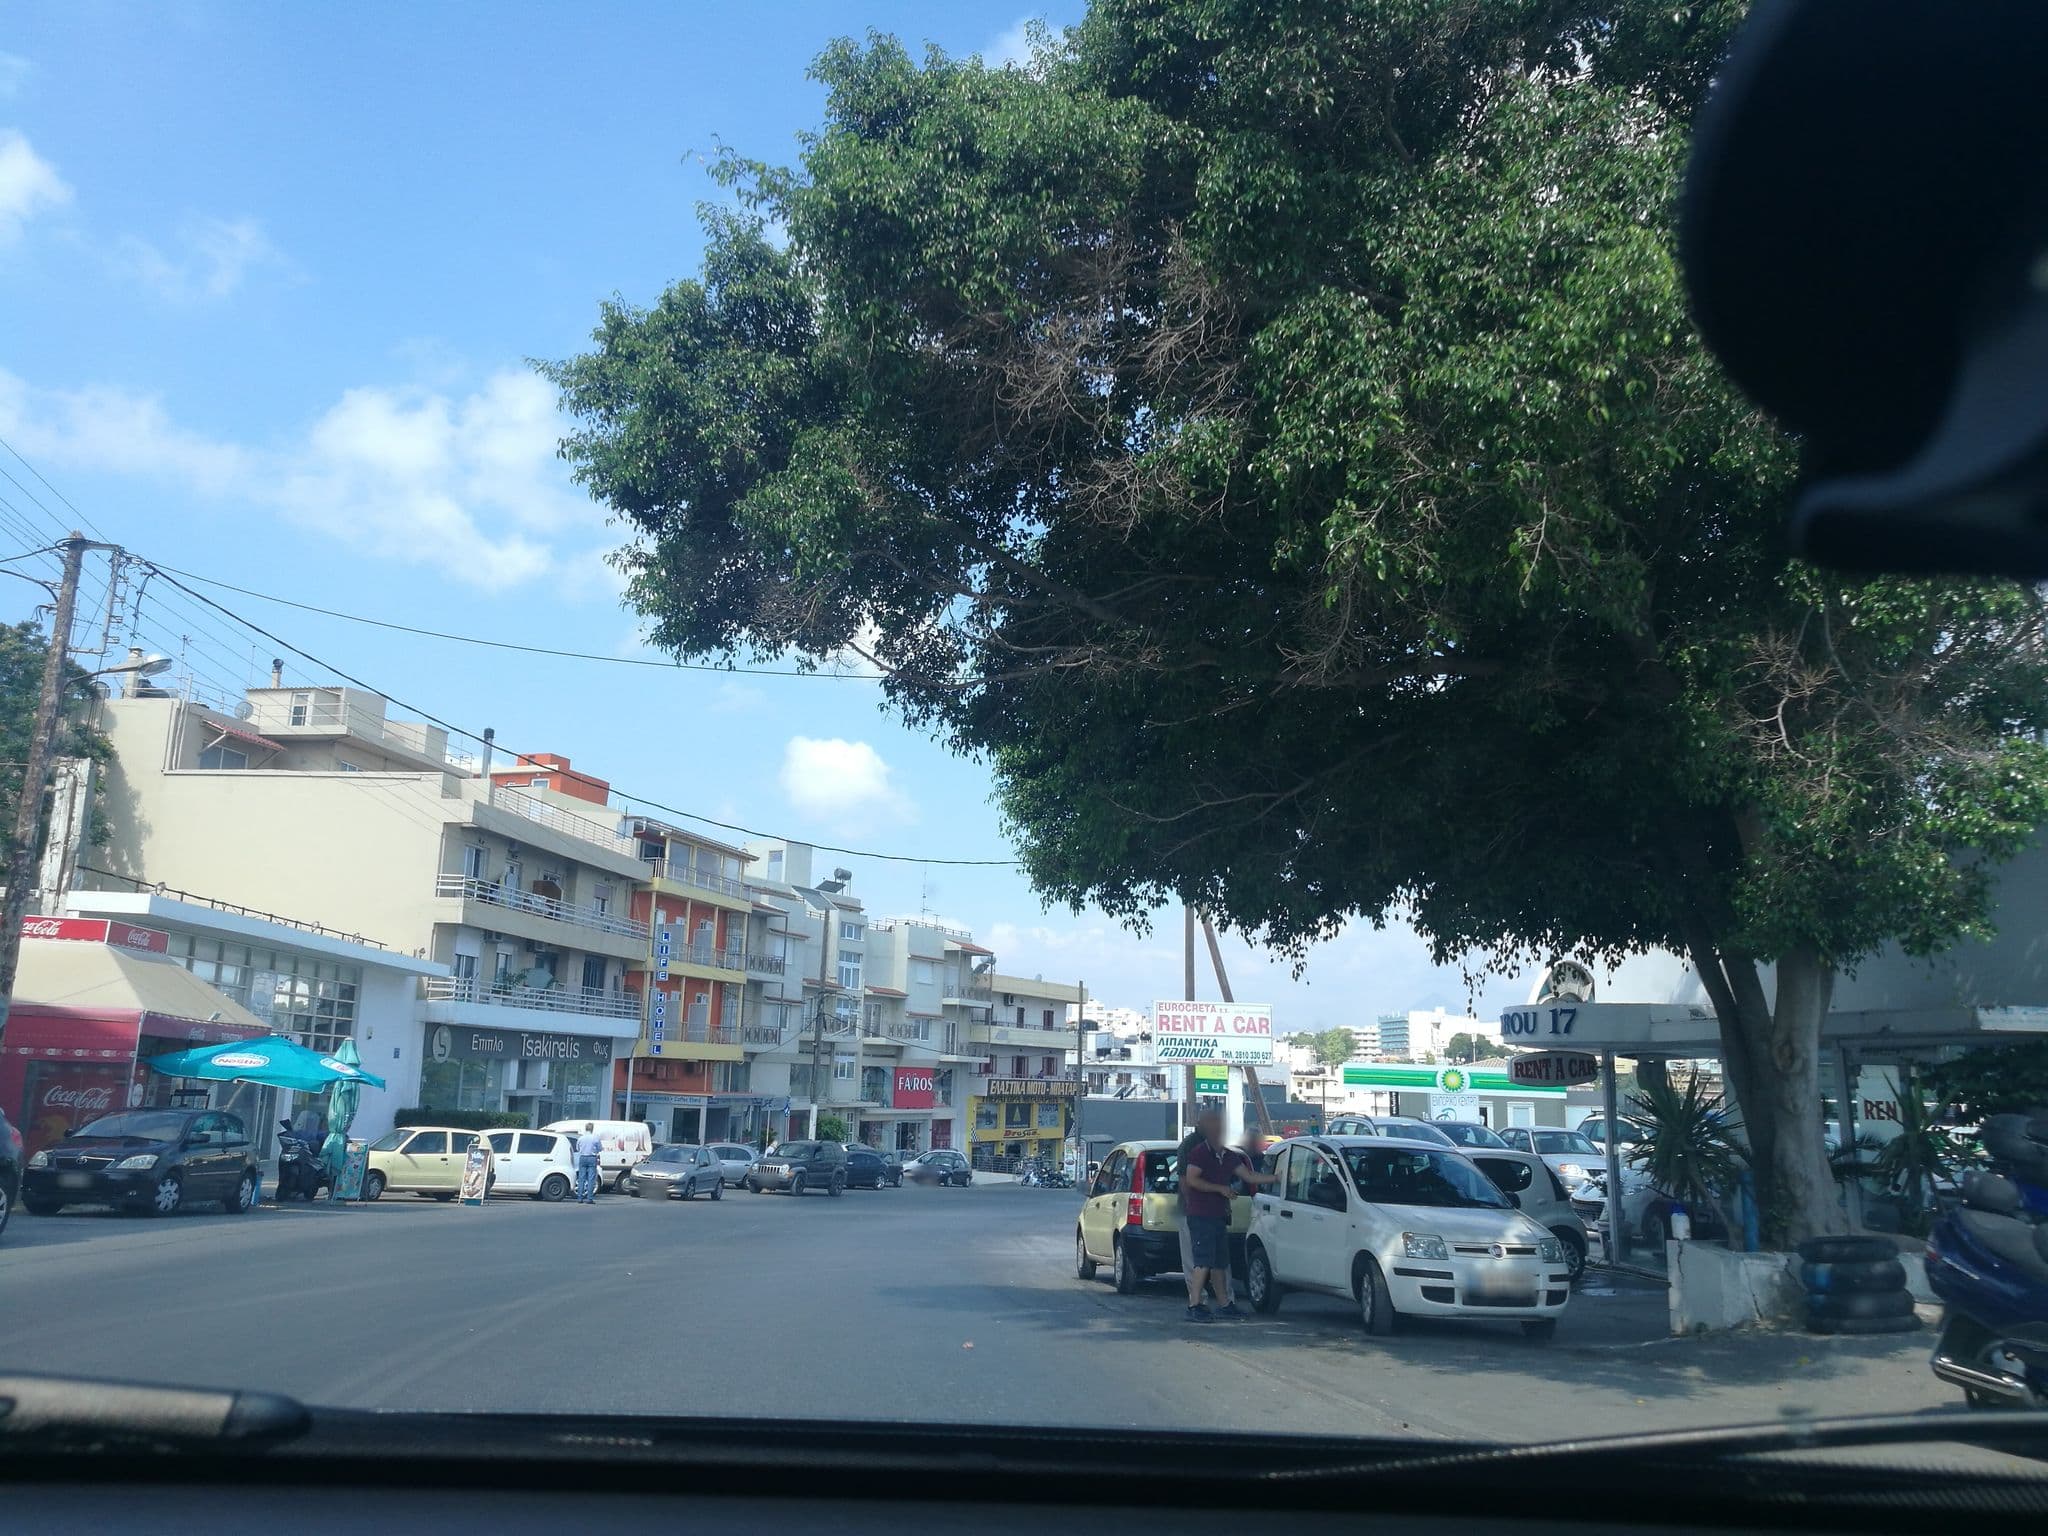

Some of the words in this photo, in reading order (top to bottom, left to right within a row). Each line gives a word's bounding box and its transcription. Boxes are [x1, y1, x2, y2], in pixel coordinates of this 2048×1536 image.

[657, 931, 670, 981] LIFE
[1158, 1002, 1217, 1013] EUROCRETA
[652, 992, 666, 1055] HOTEL
[1158, 1015, 1206, 1033] RENT
[1214, 1016, 1226, 1033] A
[1233, 1015, 1270, 1034] CAR
[1500, 1012, 1537, 1035] ROU
[1549, 1008, 1576, 1035] 17
[521, 1033, 580, 1059] Tsakirelis
[1158, 1038, 1218, 1048] ΛΙΠΑΝΤΙΚΑ
[1514, 1058, 1551, 1079] RENT
[1556, 1057, 1565, 1080] A
[898, 1076, 933, 1091] FAROS
[44, 1085, 113, 1109] Coca-Cola
